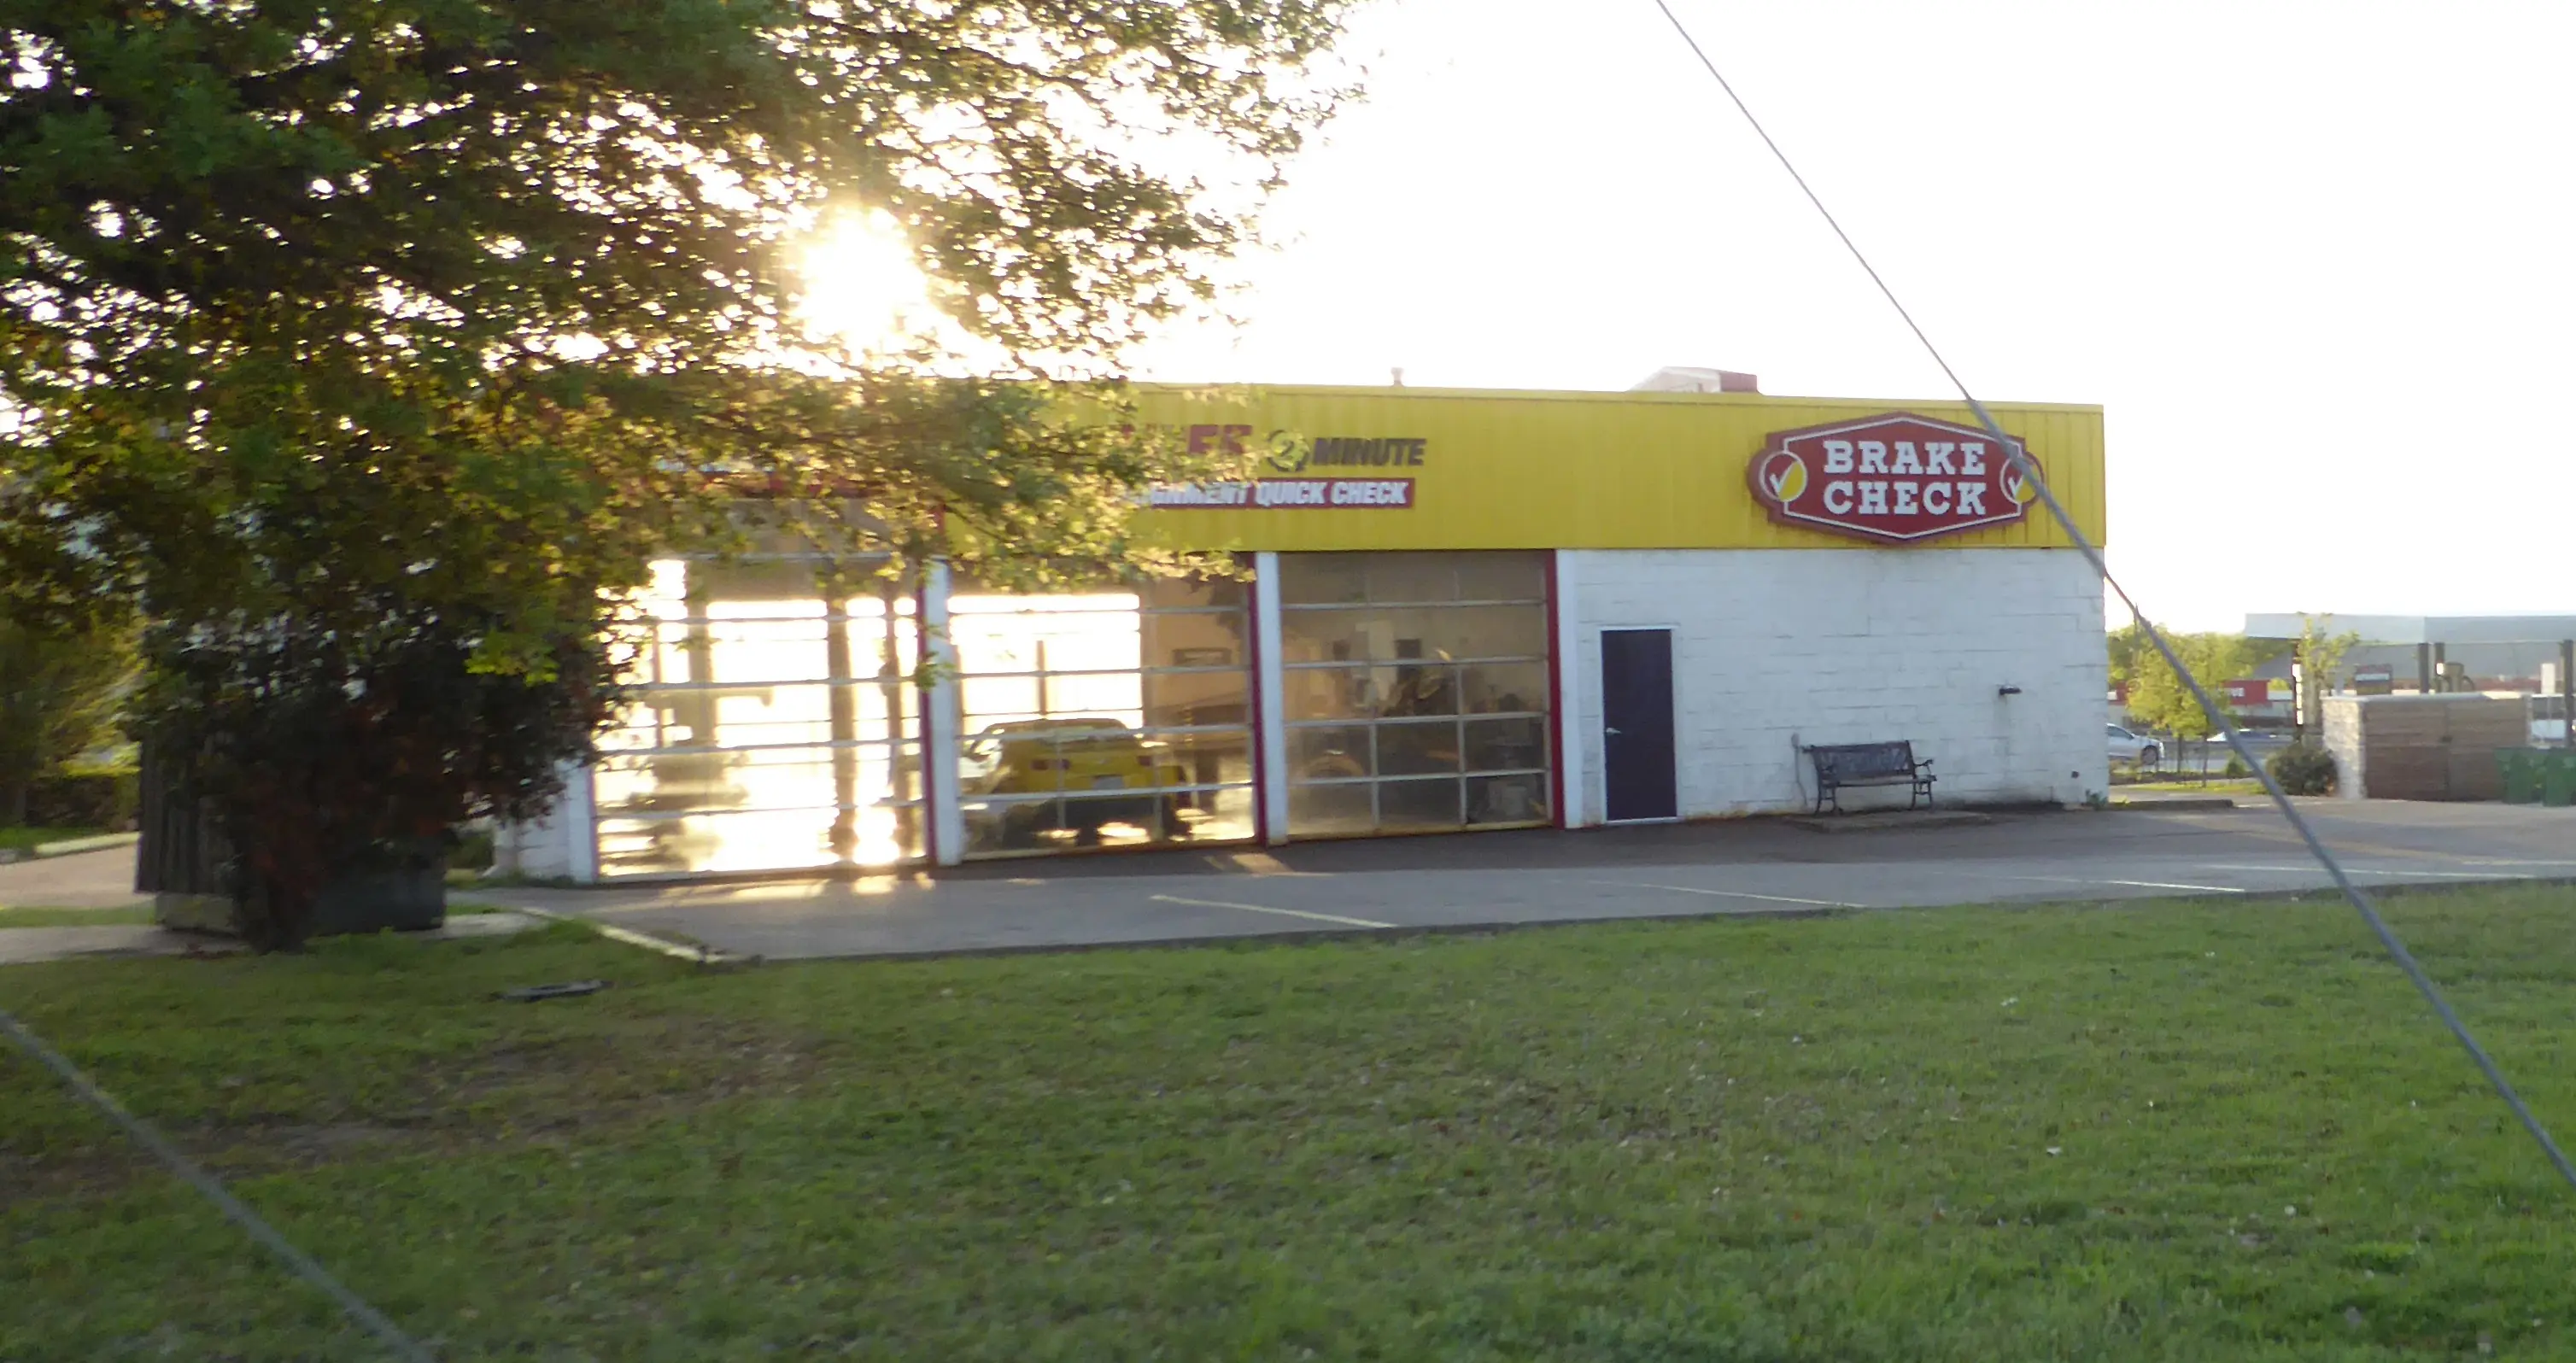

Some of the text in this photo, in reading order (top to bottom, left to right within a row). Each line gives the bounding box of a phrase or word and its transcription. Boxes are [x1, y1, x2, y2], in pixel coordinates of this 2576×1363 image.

[1313, 437, 1427, 466] MINUTE
[1823, 440, 1986, 475] BRAKE
[1255, 481, 1327, 506] QUICK
[1329, 481, 1409, 505] CHECK
[1823, 481, 1986, 515] CHECK
